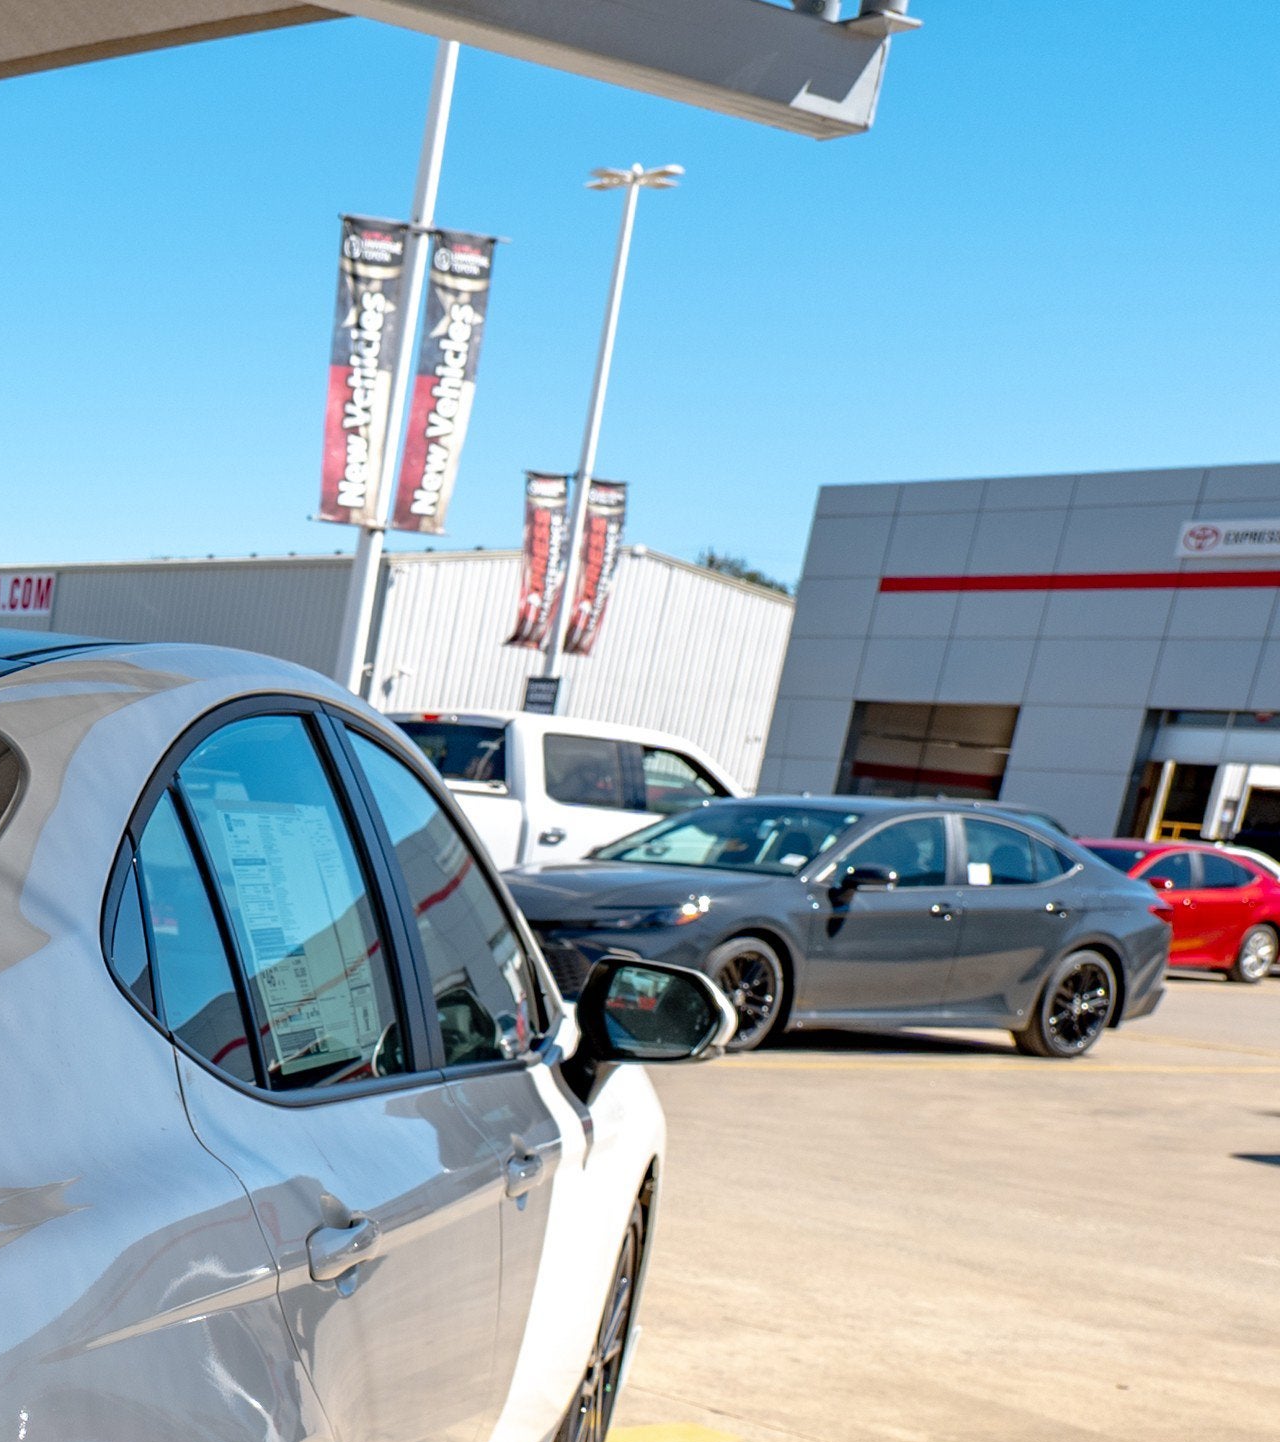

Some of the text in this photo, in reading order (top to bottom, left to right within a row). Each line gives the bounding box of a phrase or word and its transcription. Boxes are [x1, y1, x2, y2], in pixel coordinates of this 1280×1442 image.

[425, 303, 475, 439] Vehicles
[338, 433, 369, 508] New
[410, 443, 449, 517] New
